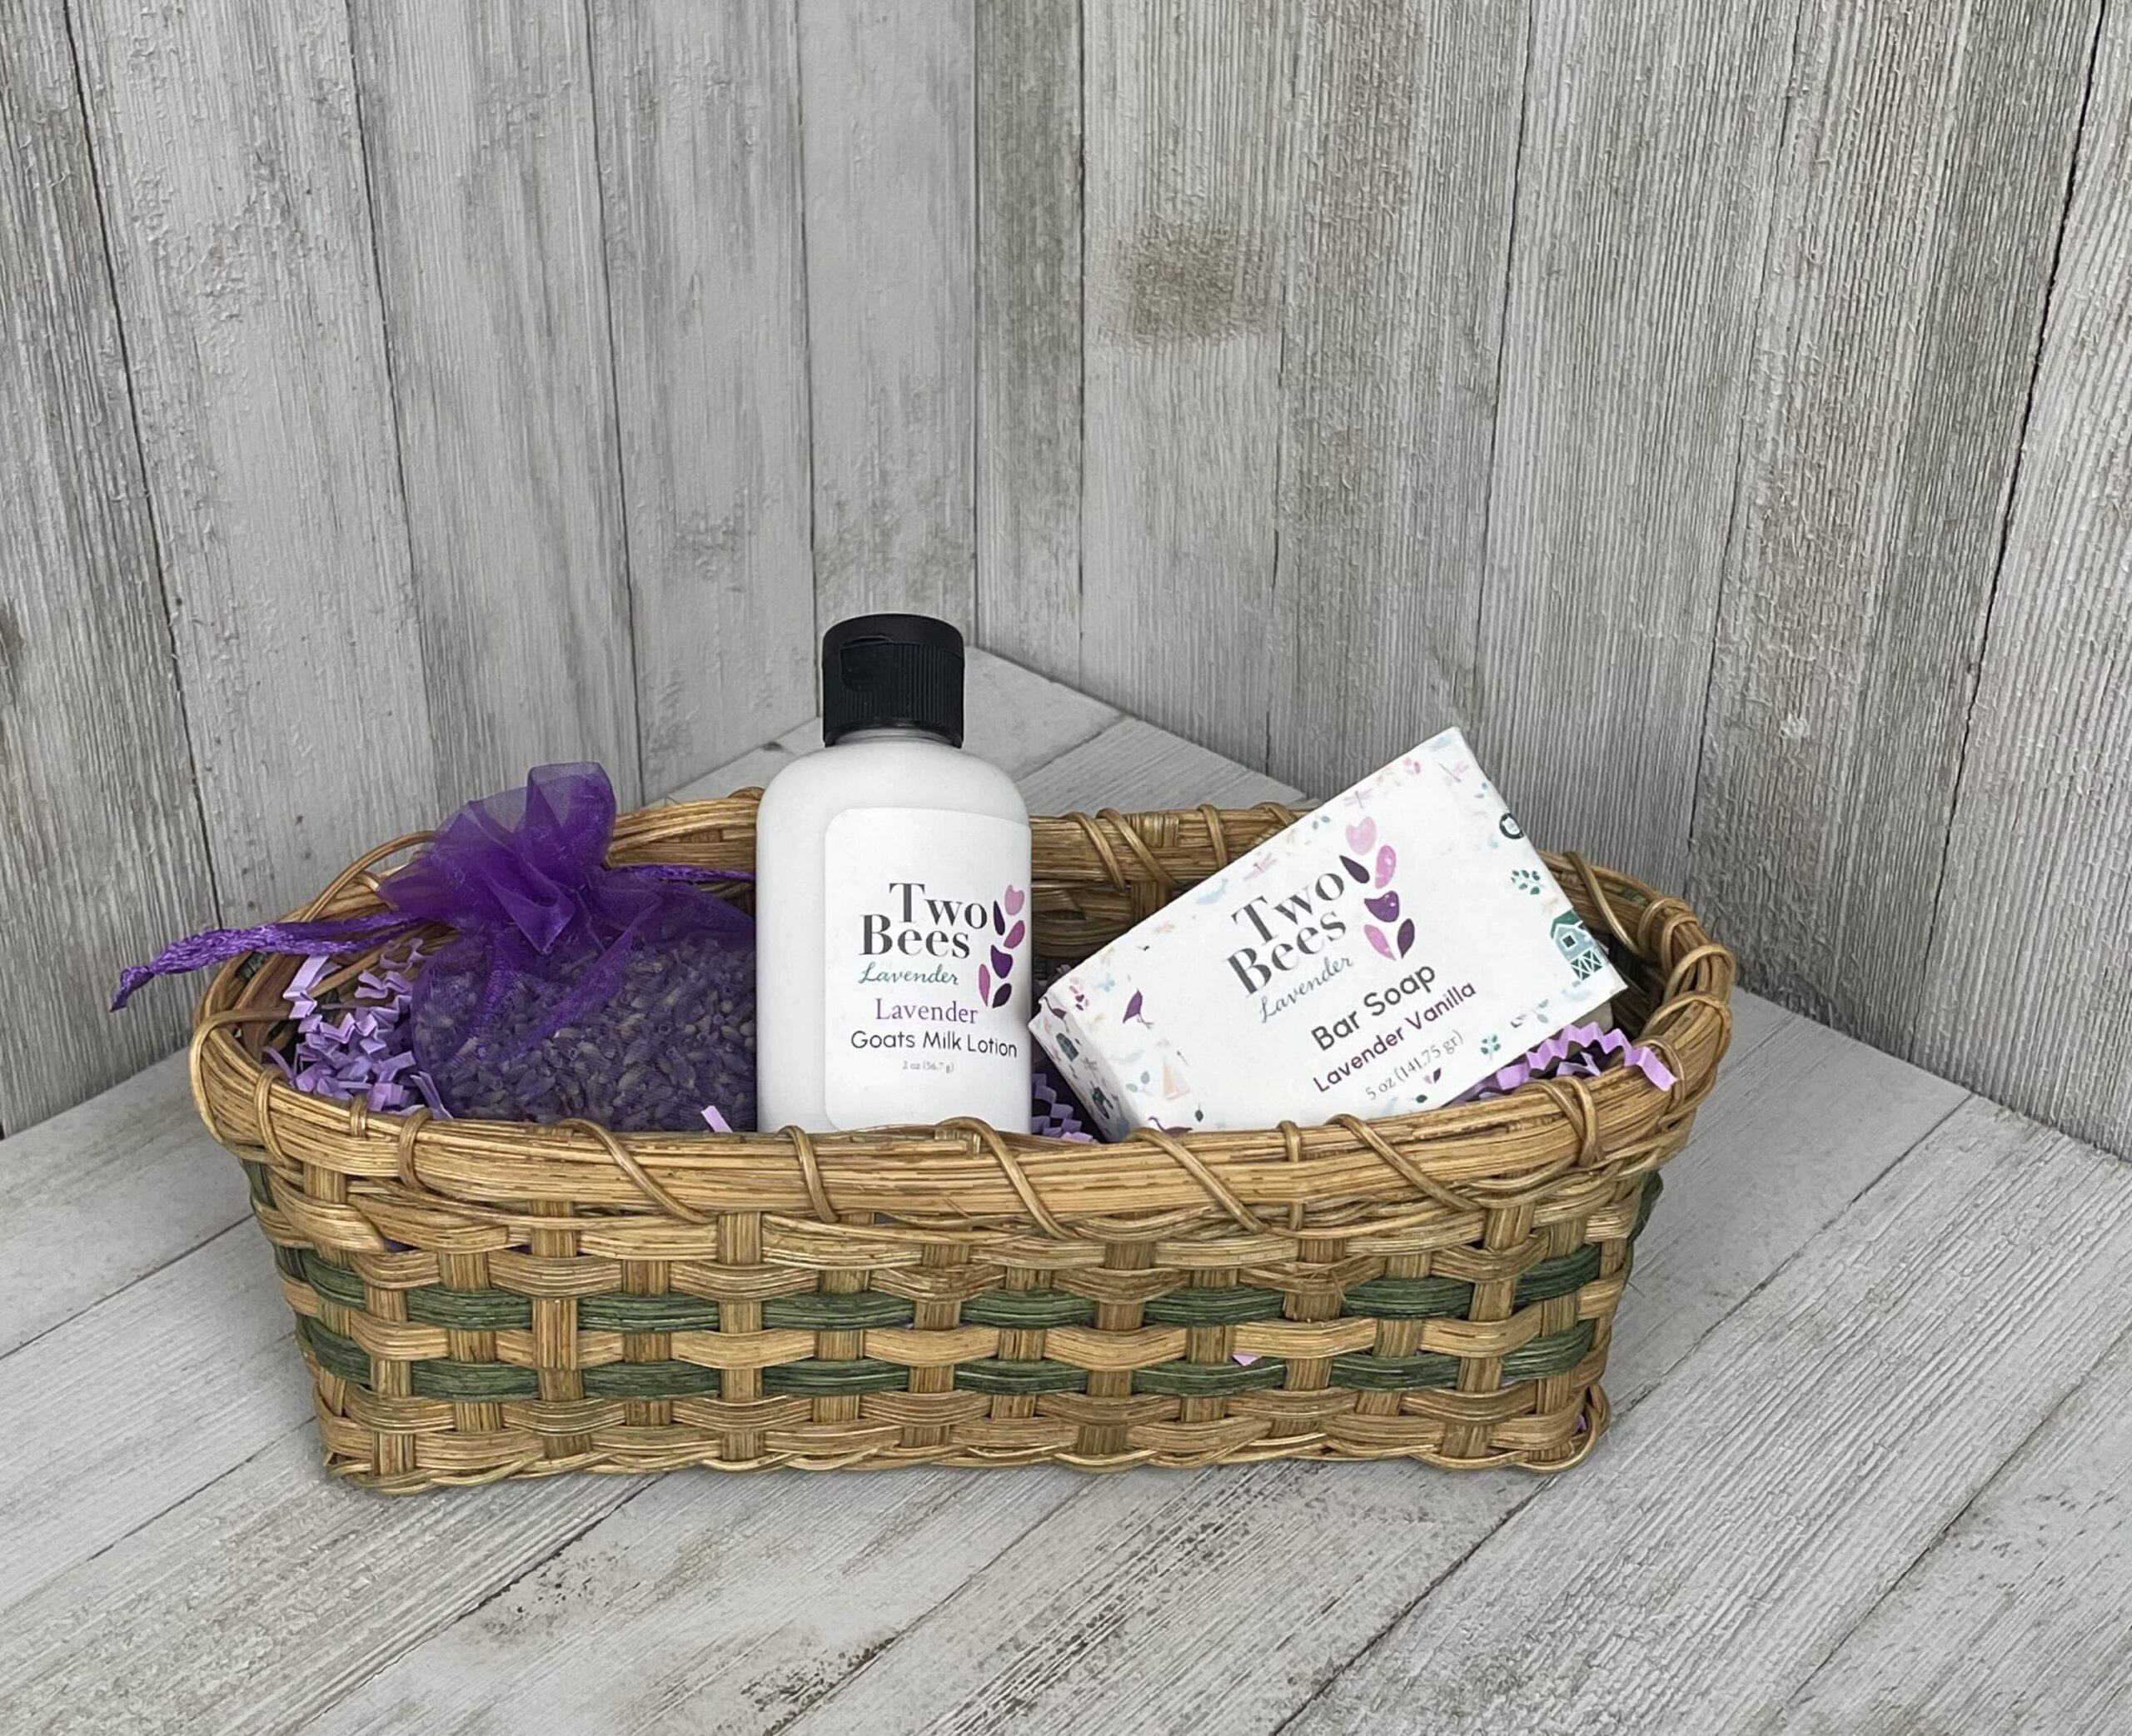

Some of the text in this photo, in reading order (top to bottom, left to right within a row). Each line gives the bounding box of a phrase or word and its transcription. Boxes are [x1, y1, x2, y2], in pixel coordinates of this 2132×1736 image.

[889, 883, 988, 929] Two
[1231, 873, 1344, 946] Two
[859, 913, 970, 958] Bees
[1222, 911, 1347, 998] Bees
[858, 962, 959, 985] Lavender
[1258, 956, 1353, 1023] Lavender
[875, 998, 979, 1023] Lavender
[1311, 966, 1435, 1051] Bar Soap
[850, 1030, 1018, 1057] Goats Milk Lotion
[1313, 982, 1477, 1092] Lavender Vanilla
[1365, 1030, 1464, 1100] 5 oz (141.75 gr)
[902, 1061, 908, 1070] 2
